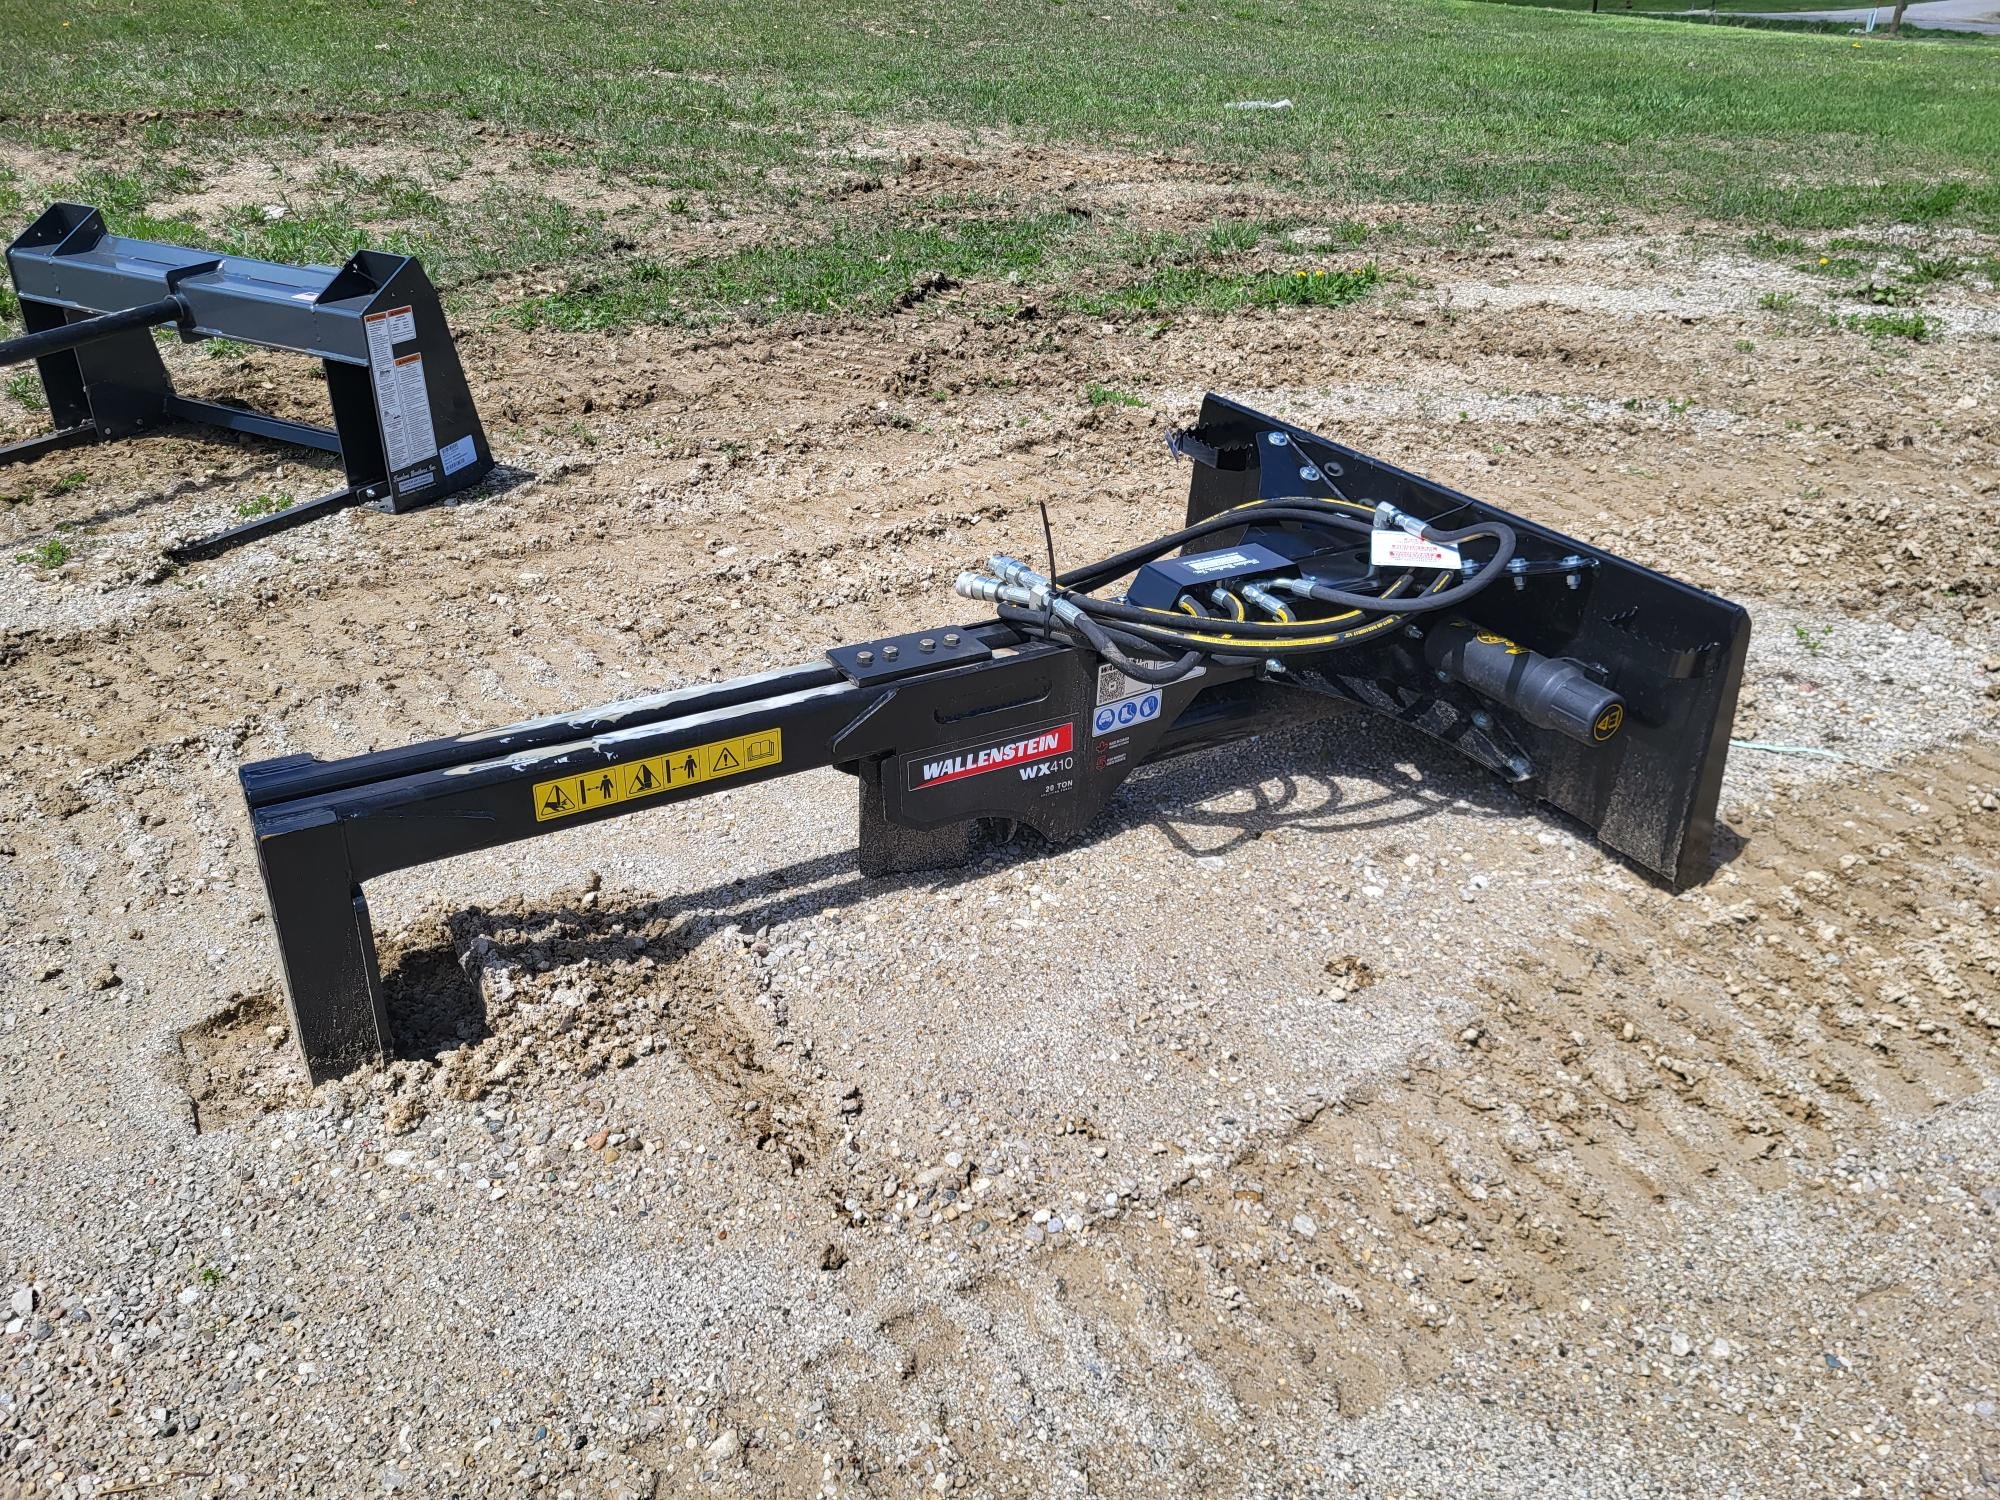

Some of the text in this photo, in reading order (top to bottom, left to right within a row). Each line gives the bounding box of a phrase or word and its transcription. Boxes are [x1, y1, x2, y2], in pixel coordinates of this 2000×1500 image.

[923, 733, 1059, 780] WALLENSTEIN
[1019, 757, 1073, 781] WX410
[1045, 784, 1055, 793] 20
[1056, 780, 1073, 790] TON
